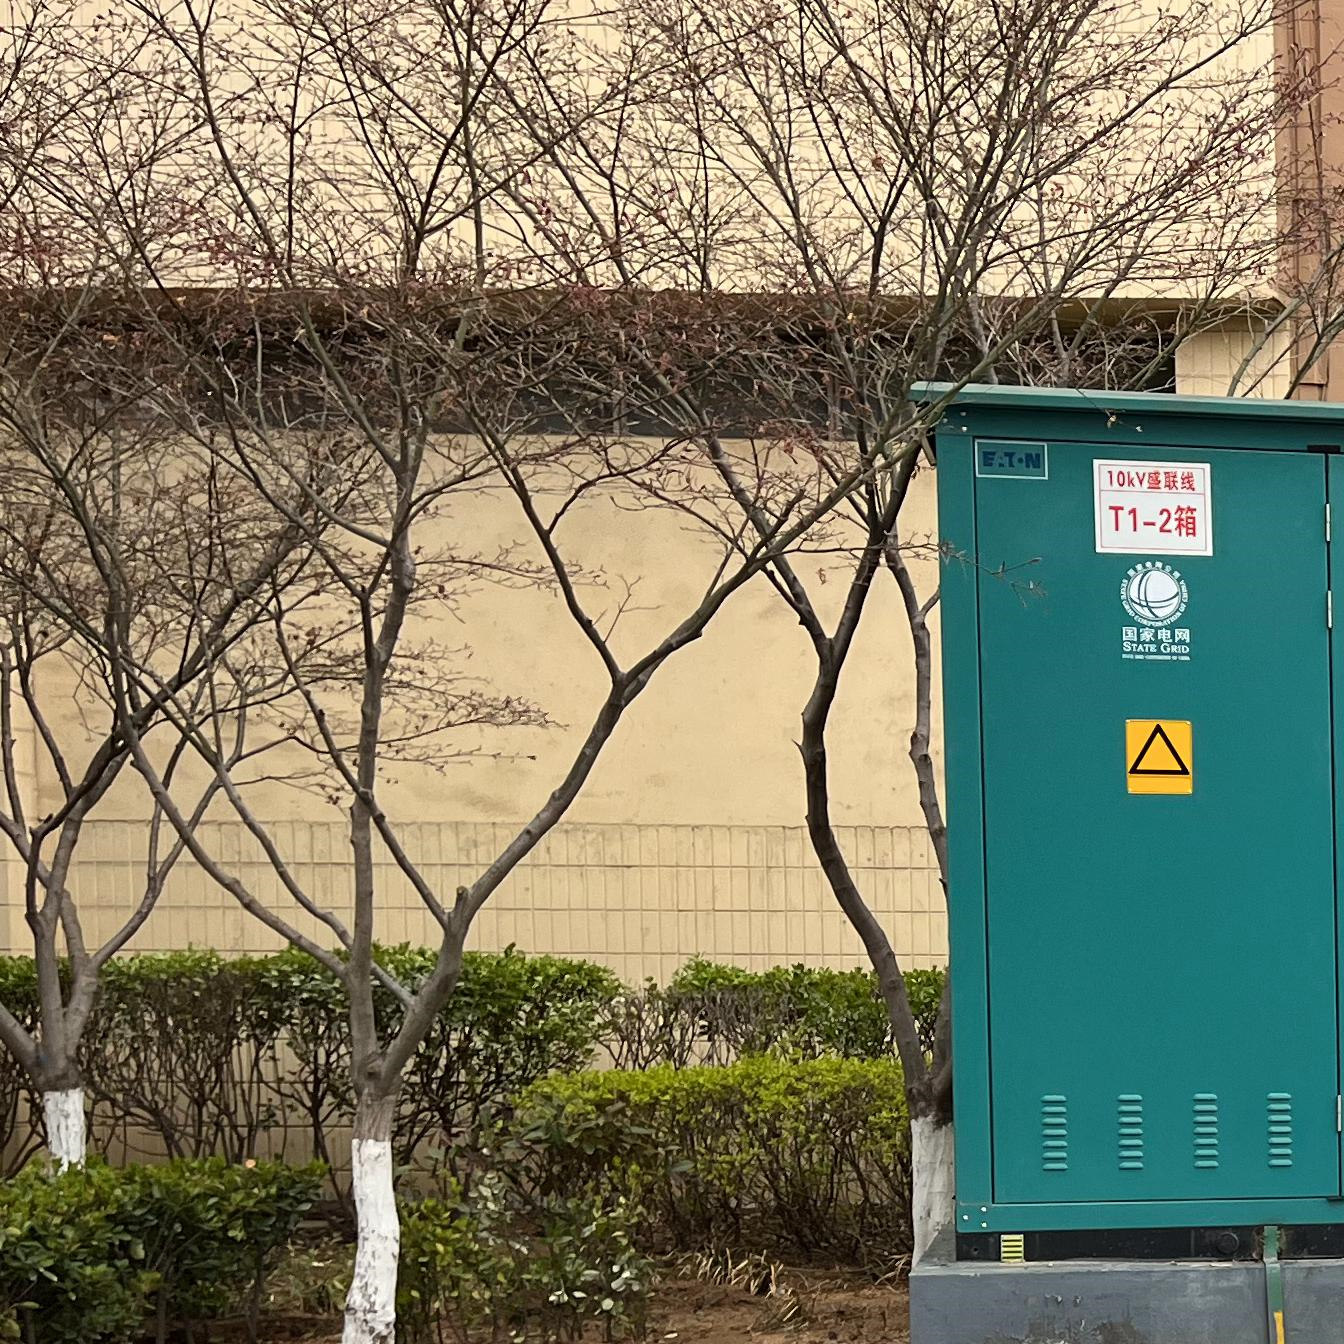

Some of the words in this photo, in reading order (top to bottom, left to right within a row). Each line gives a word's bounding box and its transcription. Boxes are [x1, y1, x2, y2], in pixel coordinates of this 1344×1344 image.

[1107, 470, 1196, 491] 10kV盛联线
[1108, 504, 1197, 537] T1-2箱
[1122, 626, 1191, 643] 国家电网
